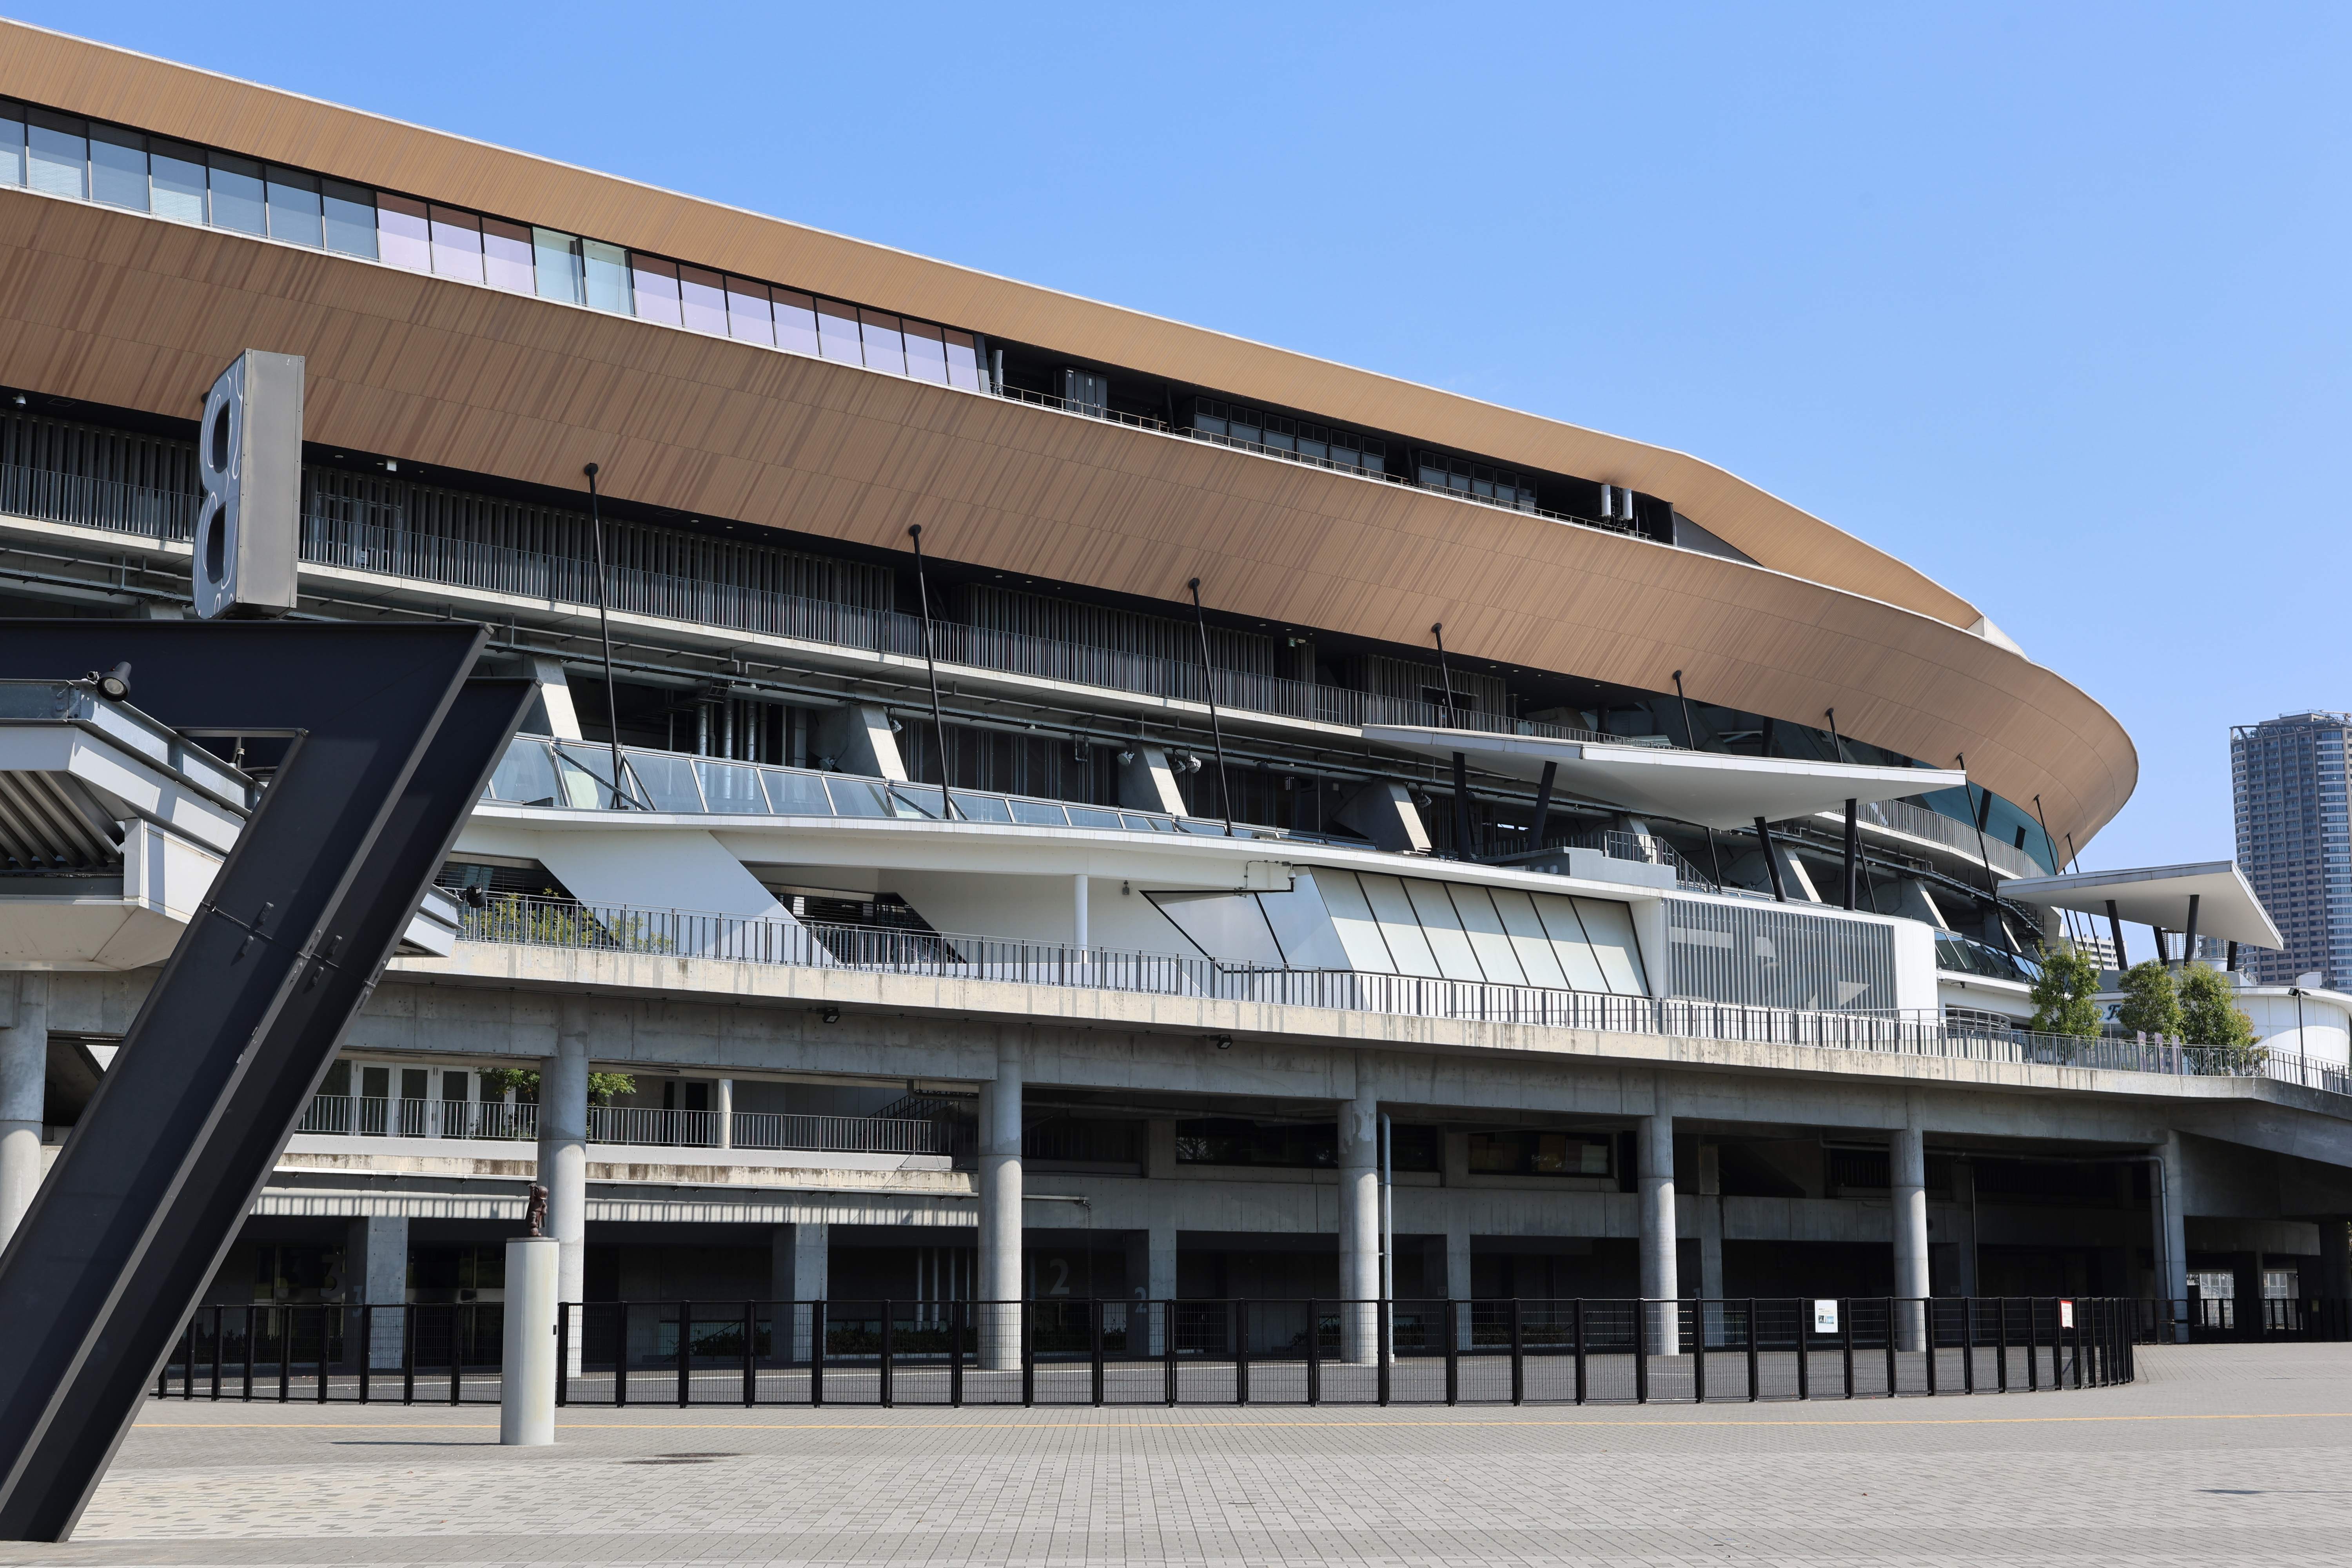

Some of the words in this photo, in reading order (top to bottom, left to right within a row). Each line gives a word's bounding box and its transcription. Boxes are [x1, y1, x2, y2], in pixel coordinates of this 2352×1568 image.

[319, 1254, 345, 1298] 3
[1049, 1258, 1070, 1294] 2
[352, 1286, 363, 1318] 3
[1134, 1287, 1147, 1313] 2
